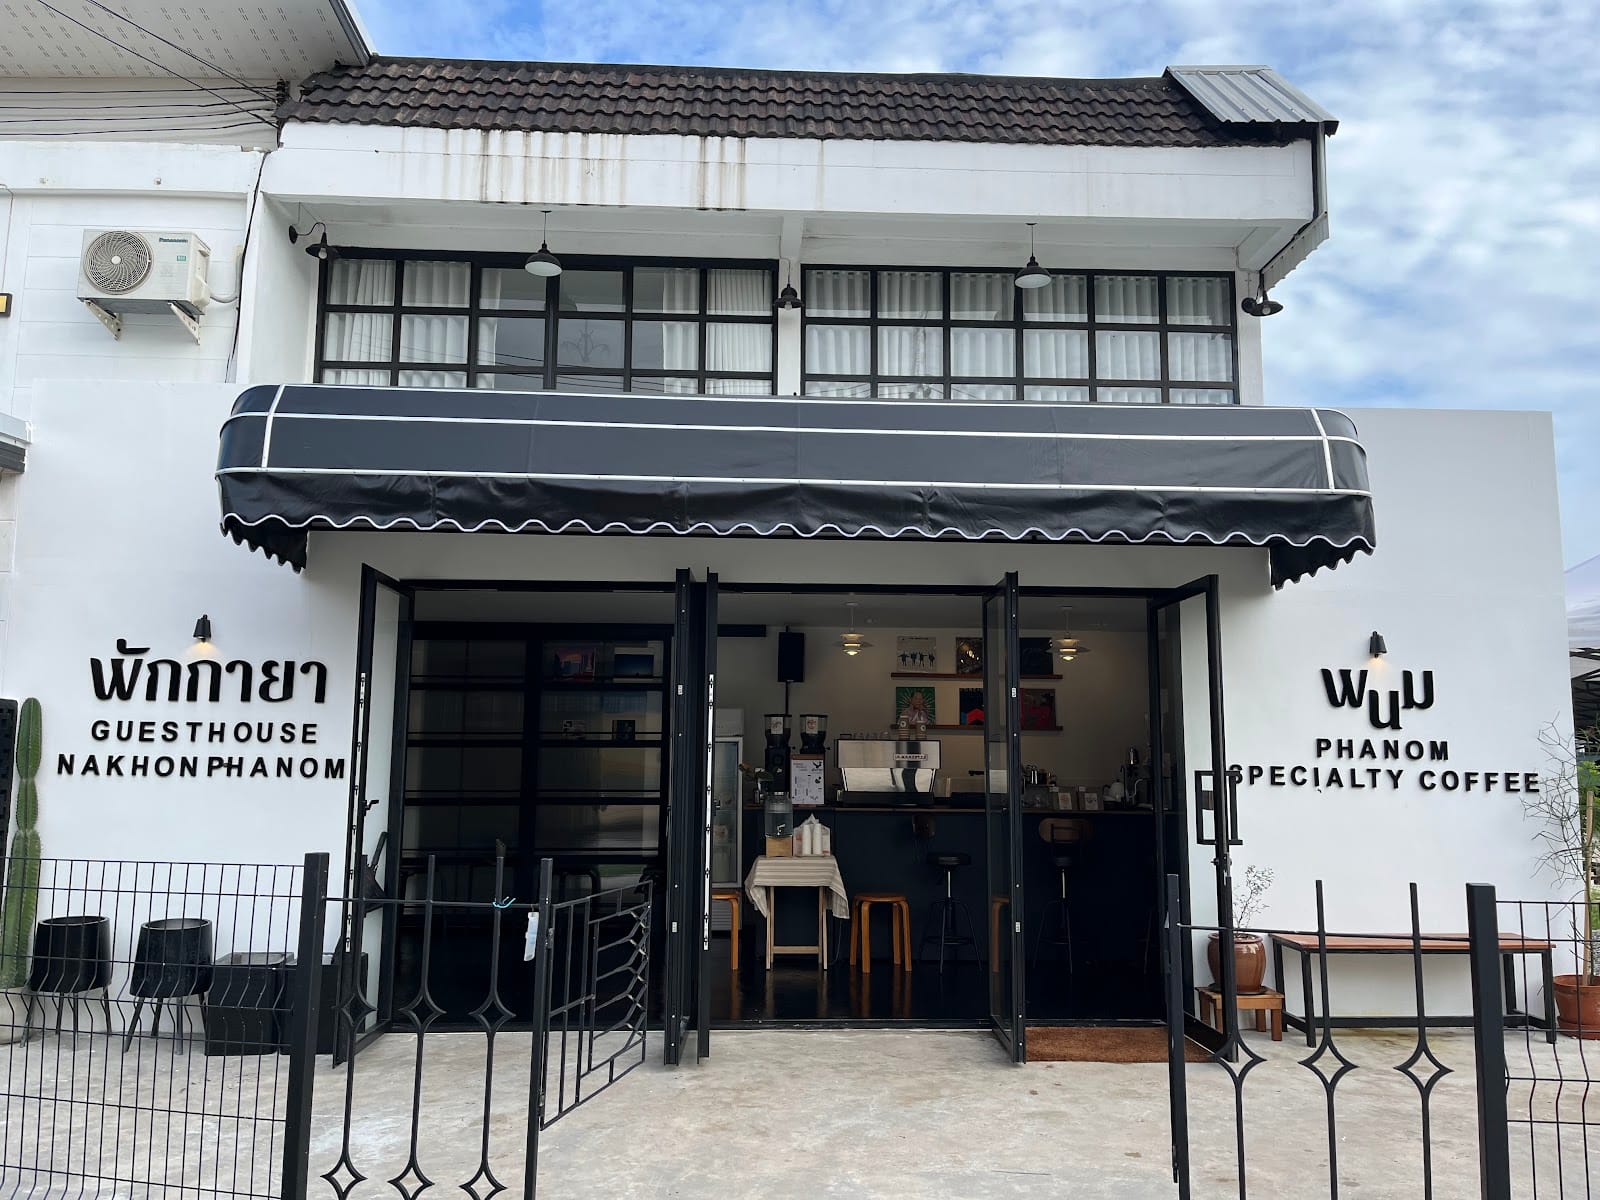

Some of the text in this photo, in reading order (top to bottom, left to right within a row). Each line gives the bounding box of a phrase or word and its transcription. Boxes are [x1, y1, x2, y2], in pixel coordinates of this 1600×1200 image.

[90, 638, 328, 704] พักกายา
[91, 719, 318, 744] GUESTHOUSE
[1316, 738, 1449, 761] PHANOM
[1228, 764, 1540, 793] SPECIALTY COFFEE
